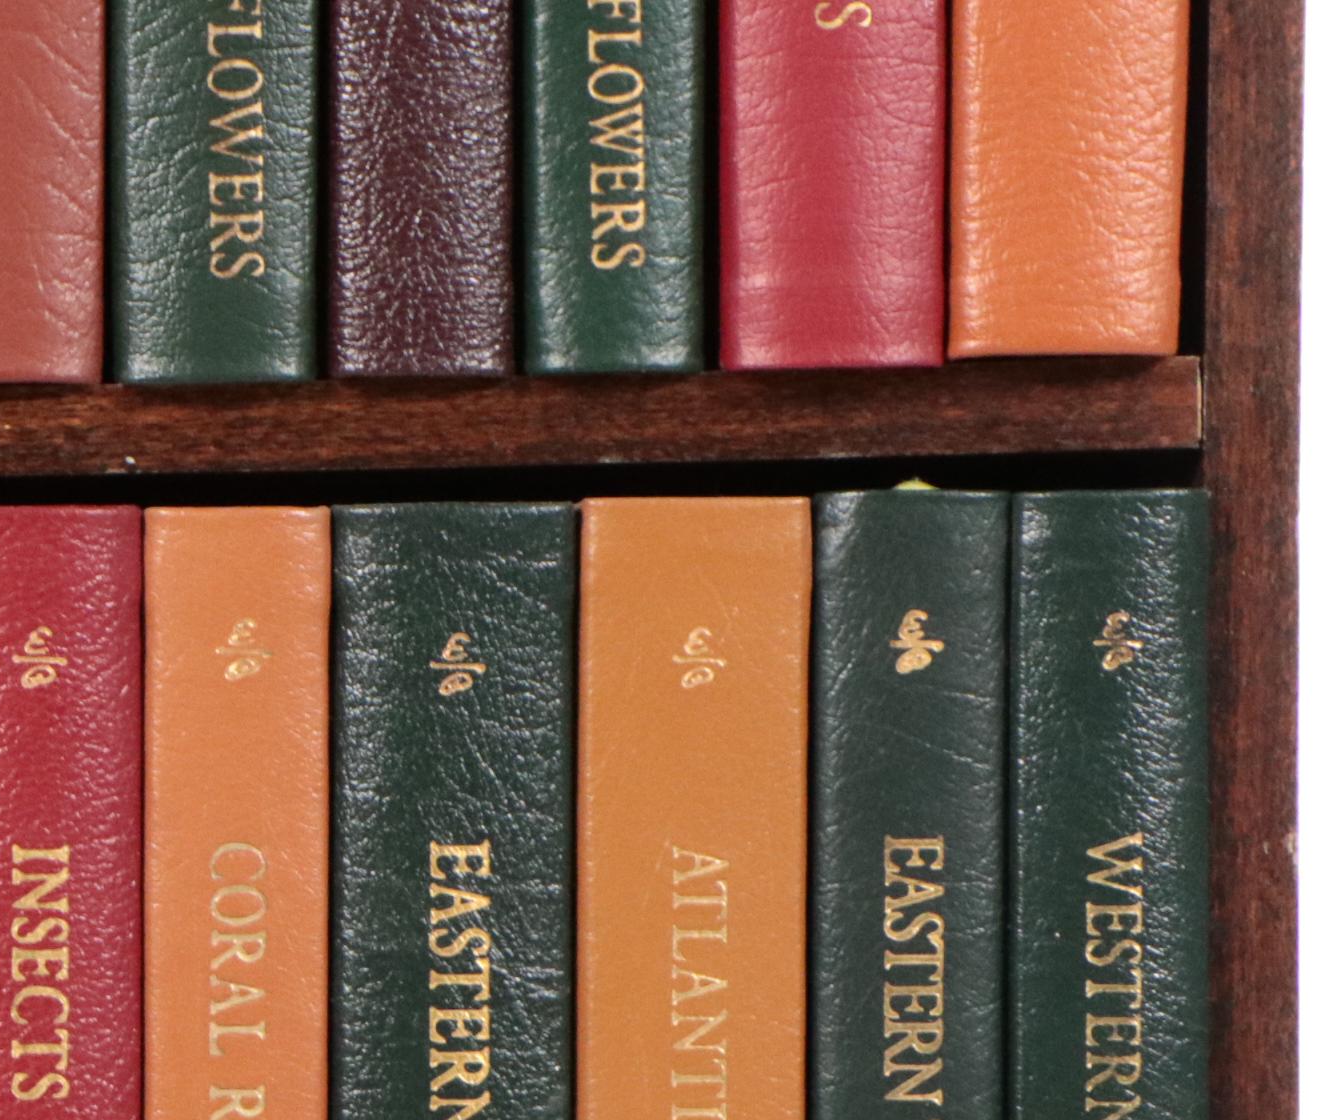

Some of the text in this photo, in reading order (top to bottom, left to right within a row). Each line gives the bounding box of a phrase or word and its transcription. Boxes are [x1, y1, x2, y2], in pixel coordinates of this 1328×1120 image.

[587, 0, 647, 272] FLOWERS
[9, 844, 70, 1102] INSECTS
[208, 841, 268, 1057] CORAL
[883, 834, 944, 1106] EASTERN
